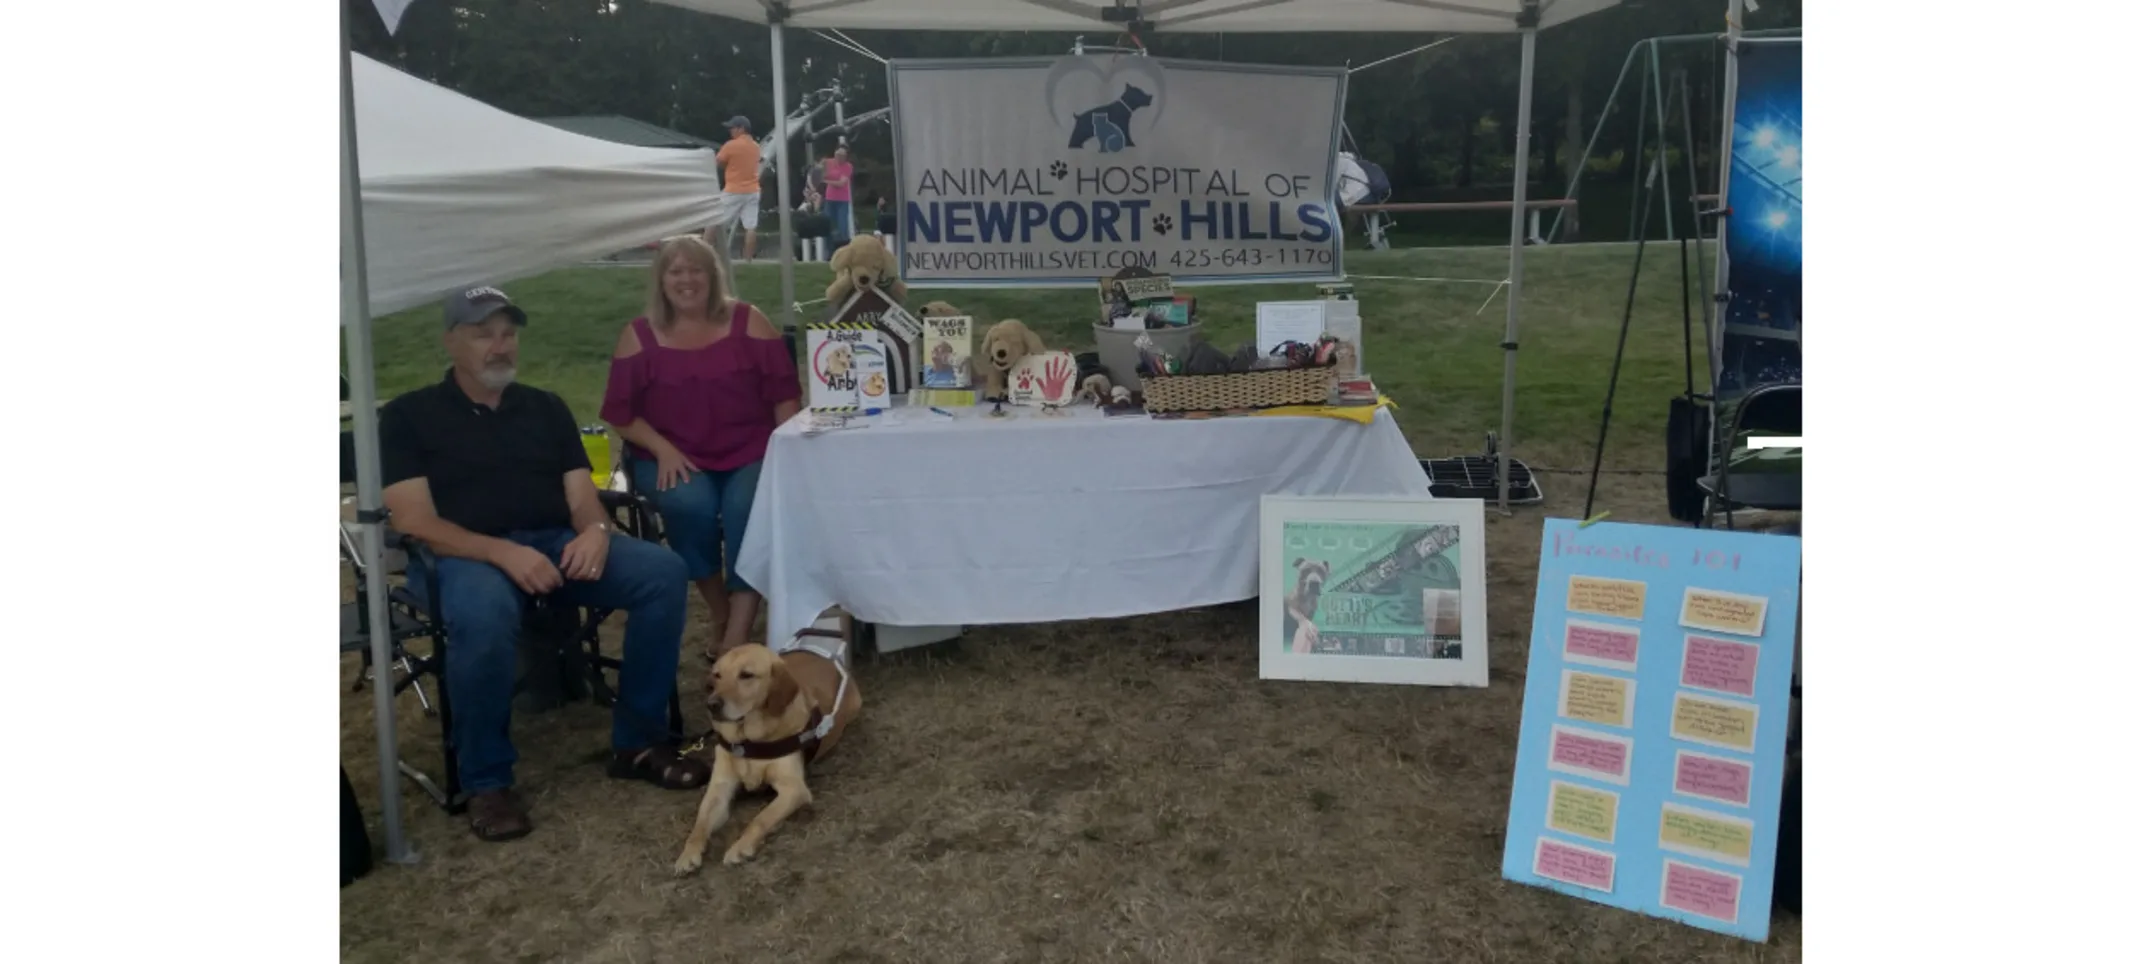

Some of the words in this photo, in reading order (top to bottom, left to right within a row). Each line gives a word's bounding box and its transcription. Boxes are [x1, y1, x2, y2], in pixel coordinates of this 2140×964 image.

[917, 167, 1054, 196] ANIMAL
[1077, 166, 1251, 197] HOSPITAL
[1265, 173, 1311, 198] OF
[907, 200, 1151, 243] NEWPORT
[1181, 200, 1332, 243] HILLS
[906, 250, 1157, 270] NEWPORTHILLSVET.COM
[1170, 249, 1332, 267] 425-643-1170
[928, 319, 966, 328] WAGS
[939, 328, 967, 337] YOU
[827, 330, 835, 340] A
[1692, 547, 1742, 571] 101
